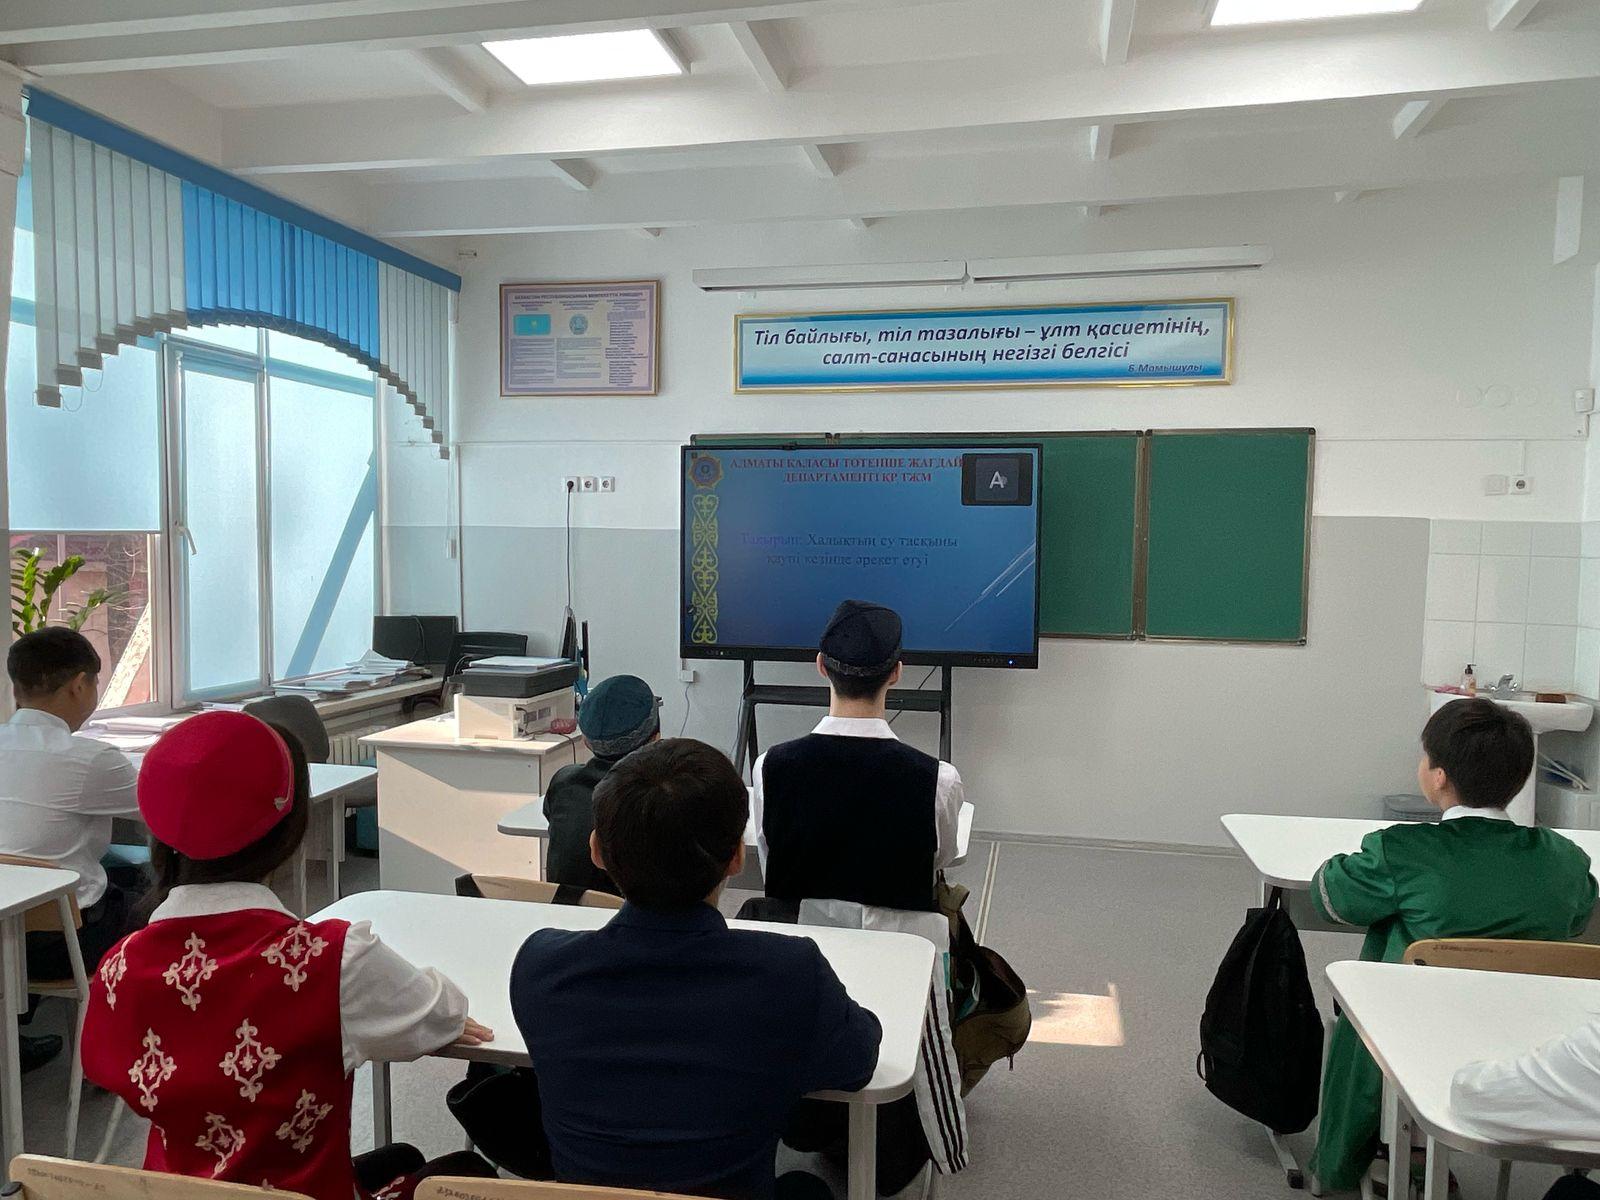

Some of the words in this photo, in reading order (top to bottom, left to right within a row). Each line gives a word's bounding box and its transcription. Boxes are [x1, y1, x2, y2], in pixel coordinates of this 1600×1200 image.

[754, 329, 780, 346] Тіл
[784, 327, 872, 346] байлығы,
[877, 326, 913, 342] тіл
[917, 326, 1021, 342] тазалығы
[1040, 324, 1081, 342] ұлт
[1086, 316, 1211, 340] қасиетінің,
[822, 348, 986, 365] салт-санасының
[992, 344, 1057, 361] негізгі
[1061, 341, 1131, 360] белгісі
[880, 537, 895, 549] су
